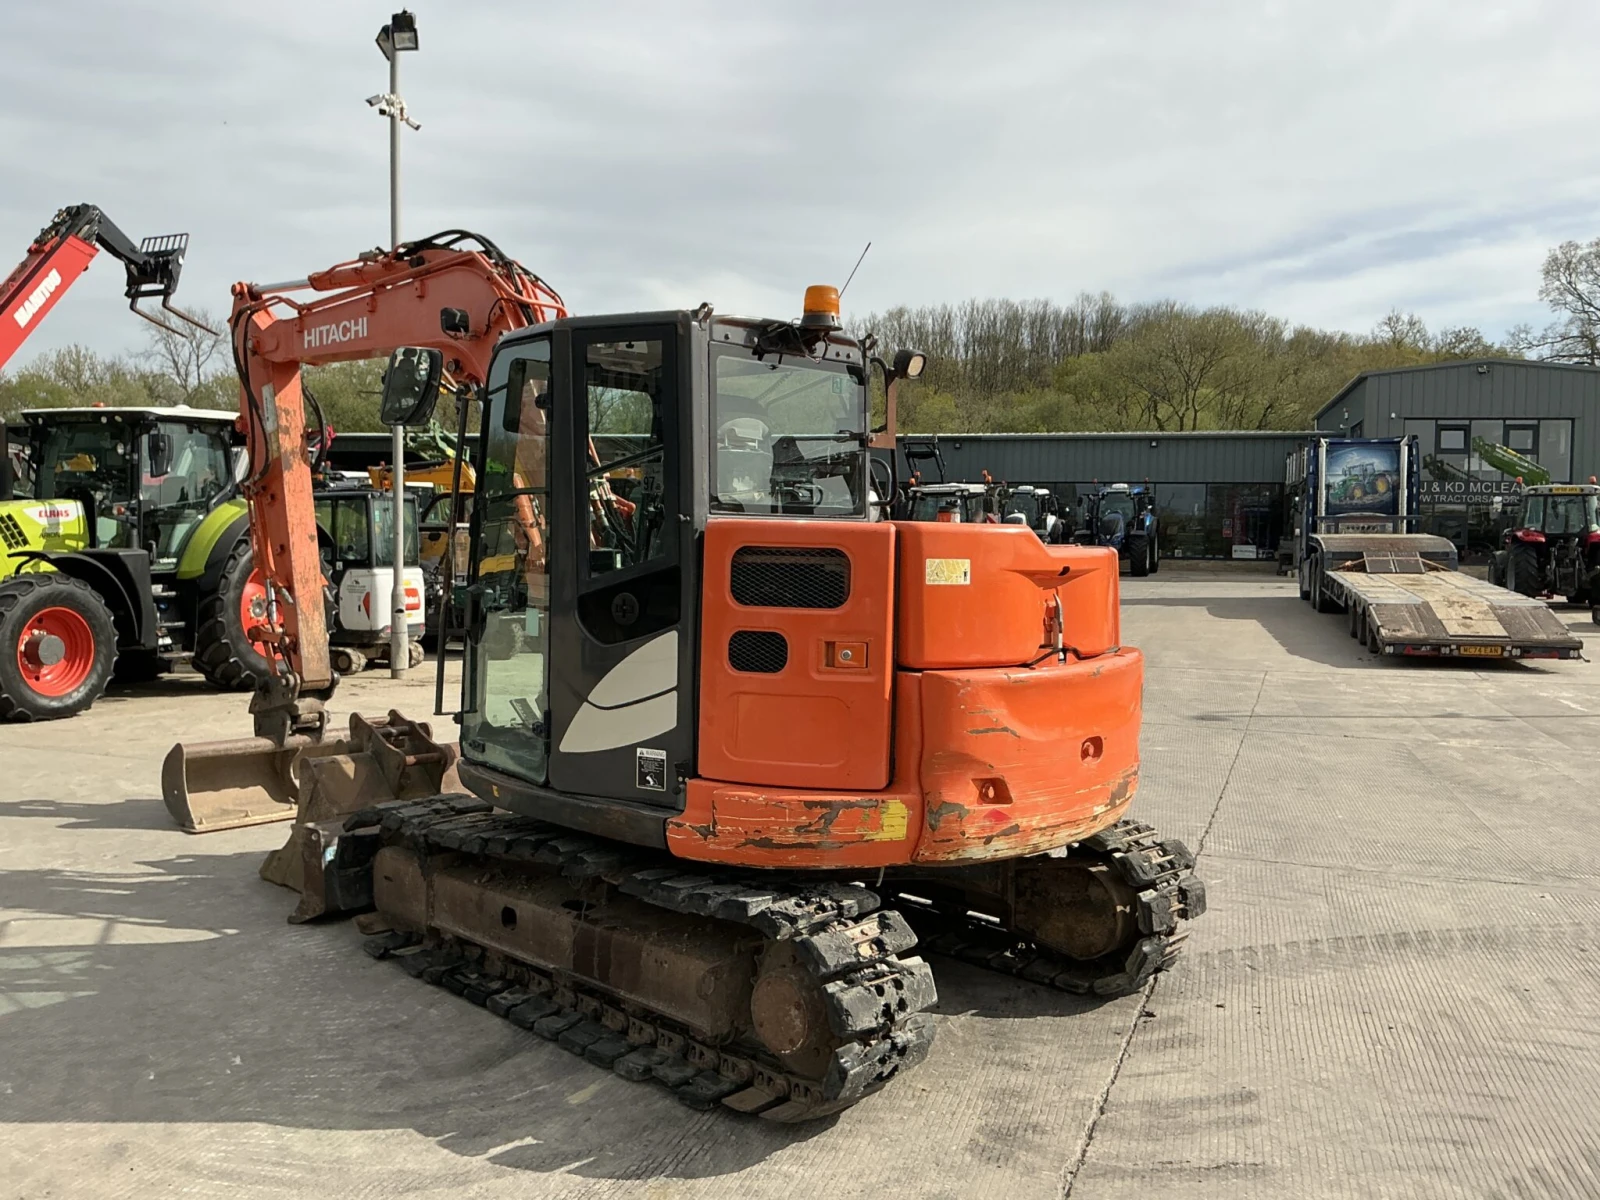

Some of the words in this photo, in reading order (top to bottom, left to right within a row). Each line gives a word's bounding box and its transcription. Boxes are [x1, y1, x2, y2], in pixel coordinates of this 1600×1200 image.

[13, 267, 62, 329] MANITOU
[304, 316, 368, 349] HITACHI
[643, 476, 655, 490] 97
[1431, 481, 1440, 493] &
[1445, 481, 1465, 493] KD
[38, 509, 70, 518] CLAAS
